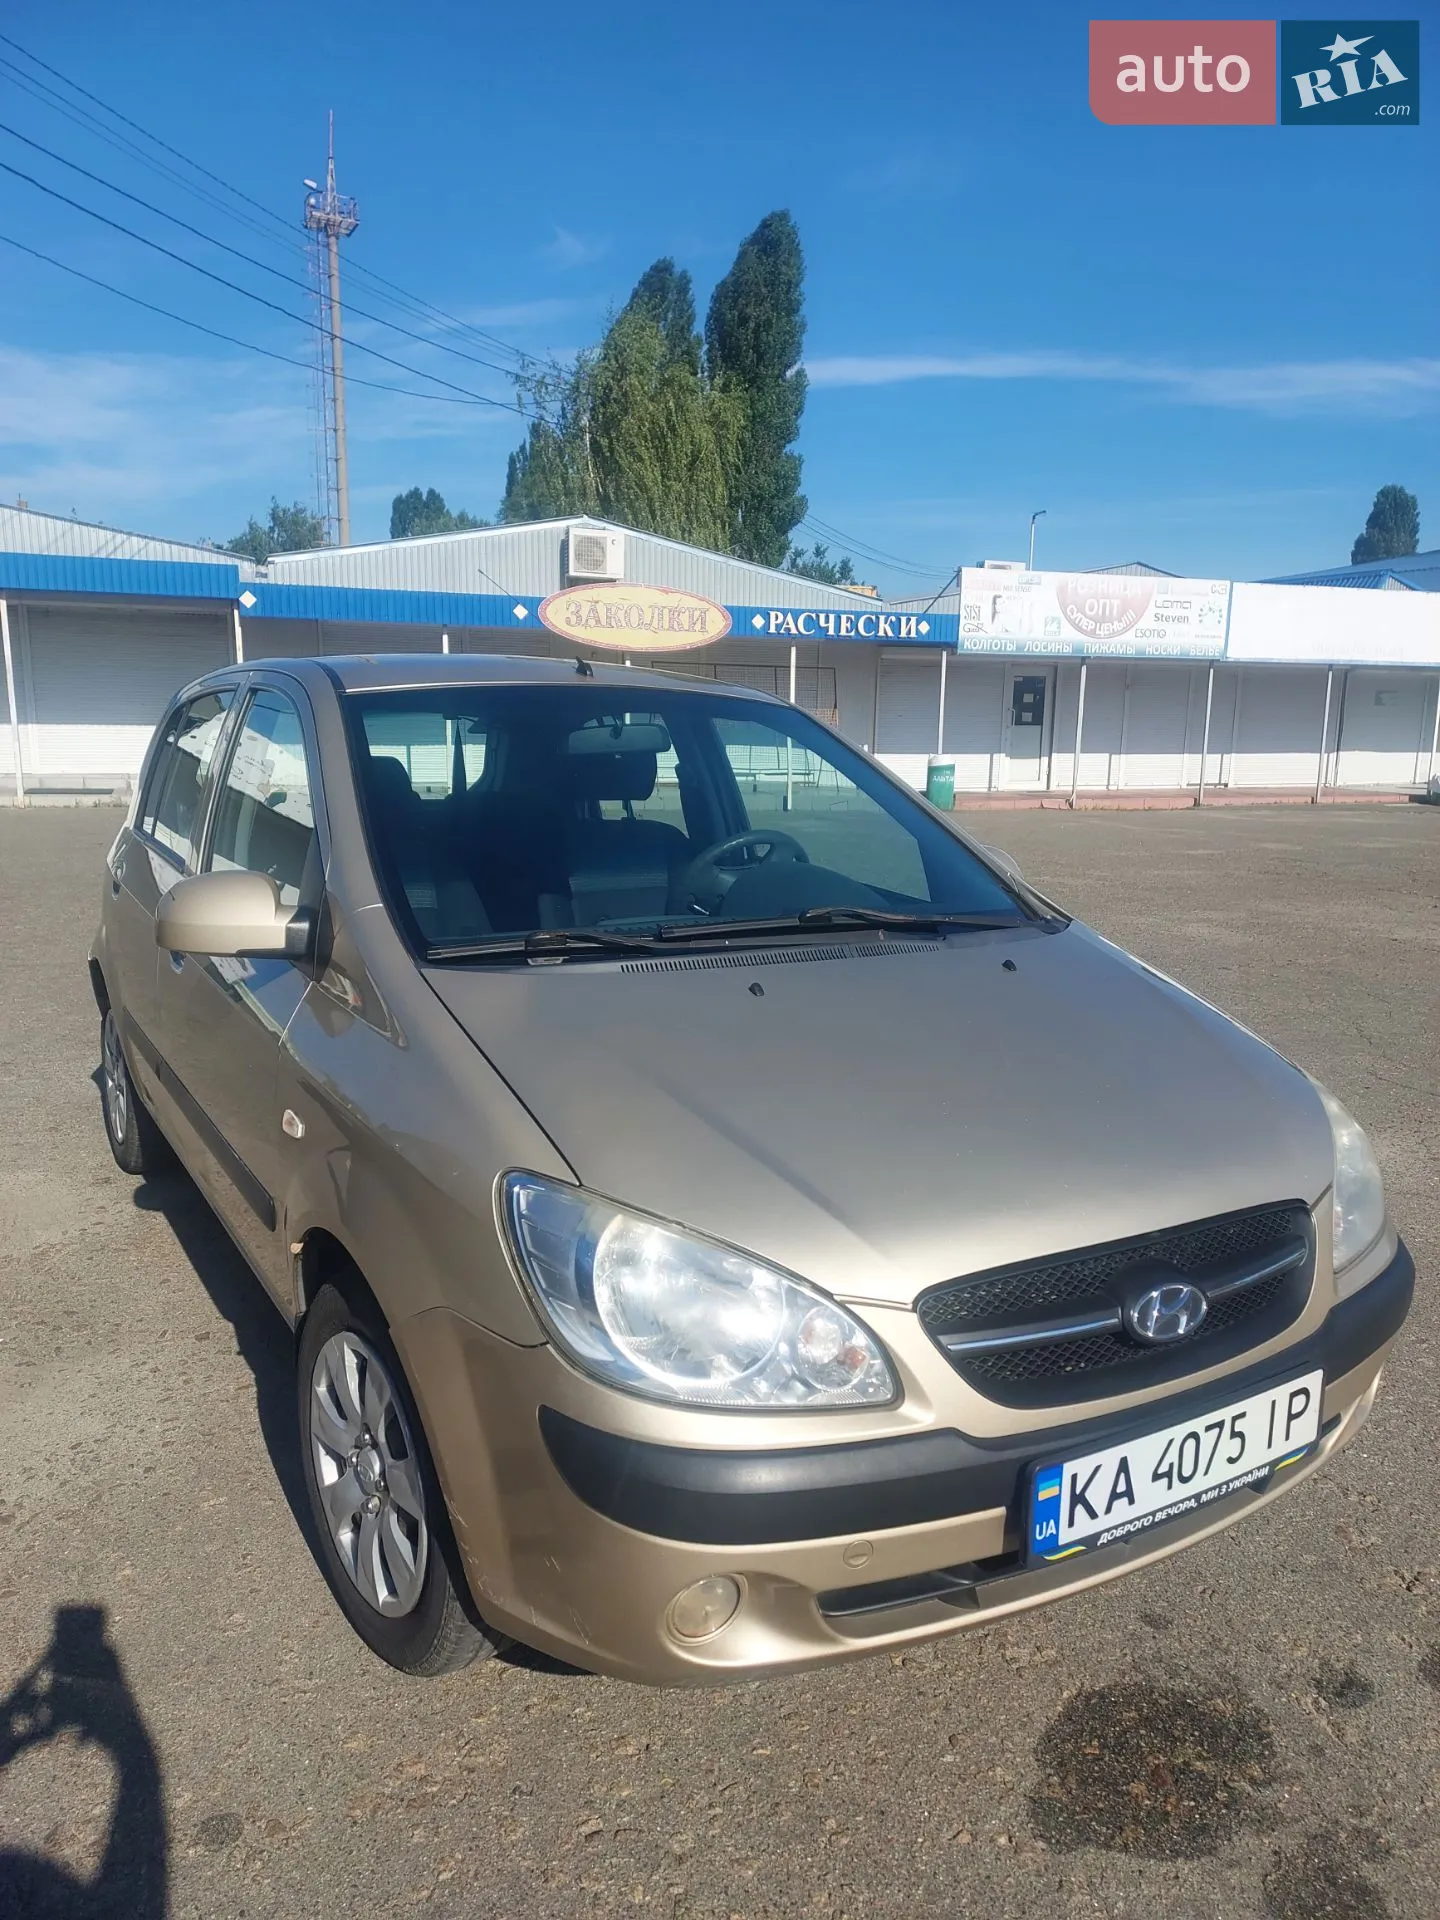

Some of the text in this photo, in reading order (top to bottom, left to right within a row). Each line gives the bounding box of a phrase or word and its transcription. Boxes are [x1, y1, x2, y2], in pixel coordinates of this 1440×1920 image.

[564, 597, 710, 634] ЗАКОЛКИ
[1066, 605, 1096, 632] СУПЕР
[1085, 598, 1121, 618] ОПТ
[1154, 612, 1189, 624] Steven
[766, 609, 918, 640] РАСЧЕСКИ
[964, 638, 1220, 656] КОЛГОТЫ ЛОСИНЫ ПИЖАМЫ НОСКИ БЕЛЬЕ
[1067, 1386, 1311, 1529] KA 4075 IP
[1097, 1515, 1153, 1547] ДОБРОГО
[1154, 1498, 1198, 1524] ВЕЧОРА,
[1199, 1489, 1219, 1505] МИ
[1226, 1465, 1270, 1495] УКРАЇНИ
[1035, 1519, 1057, 1540] UA
